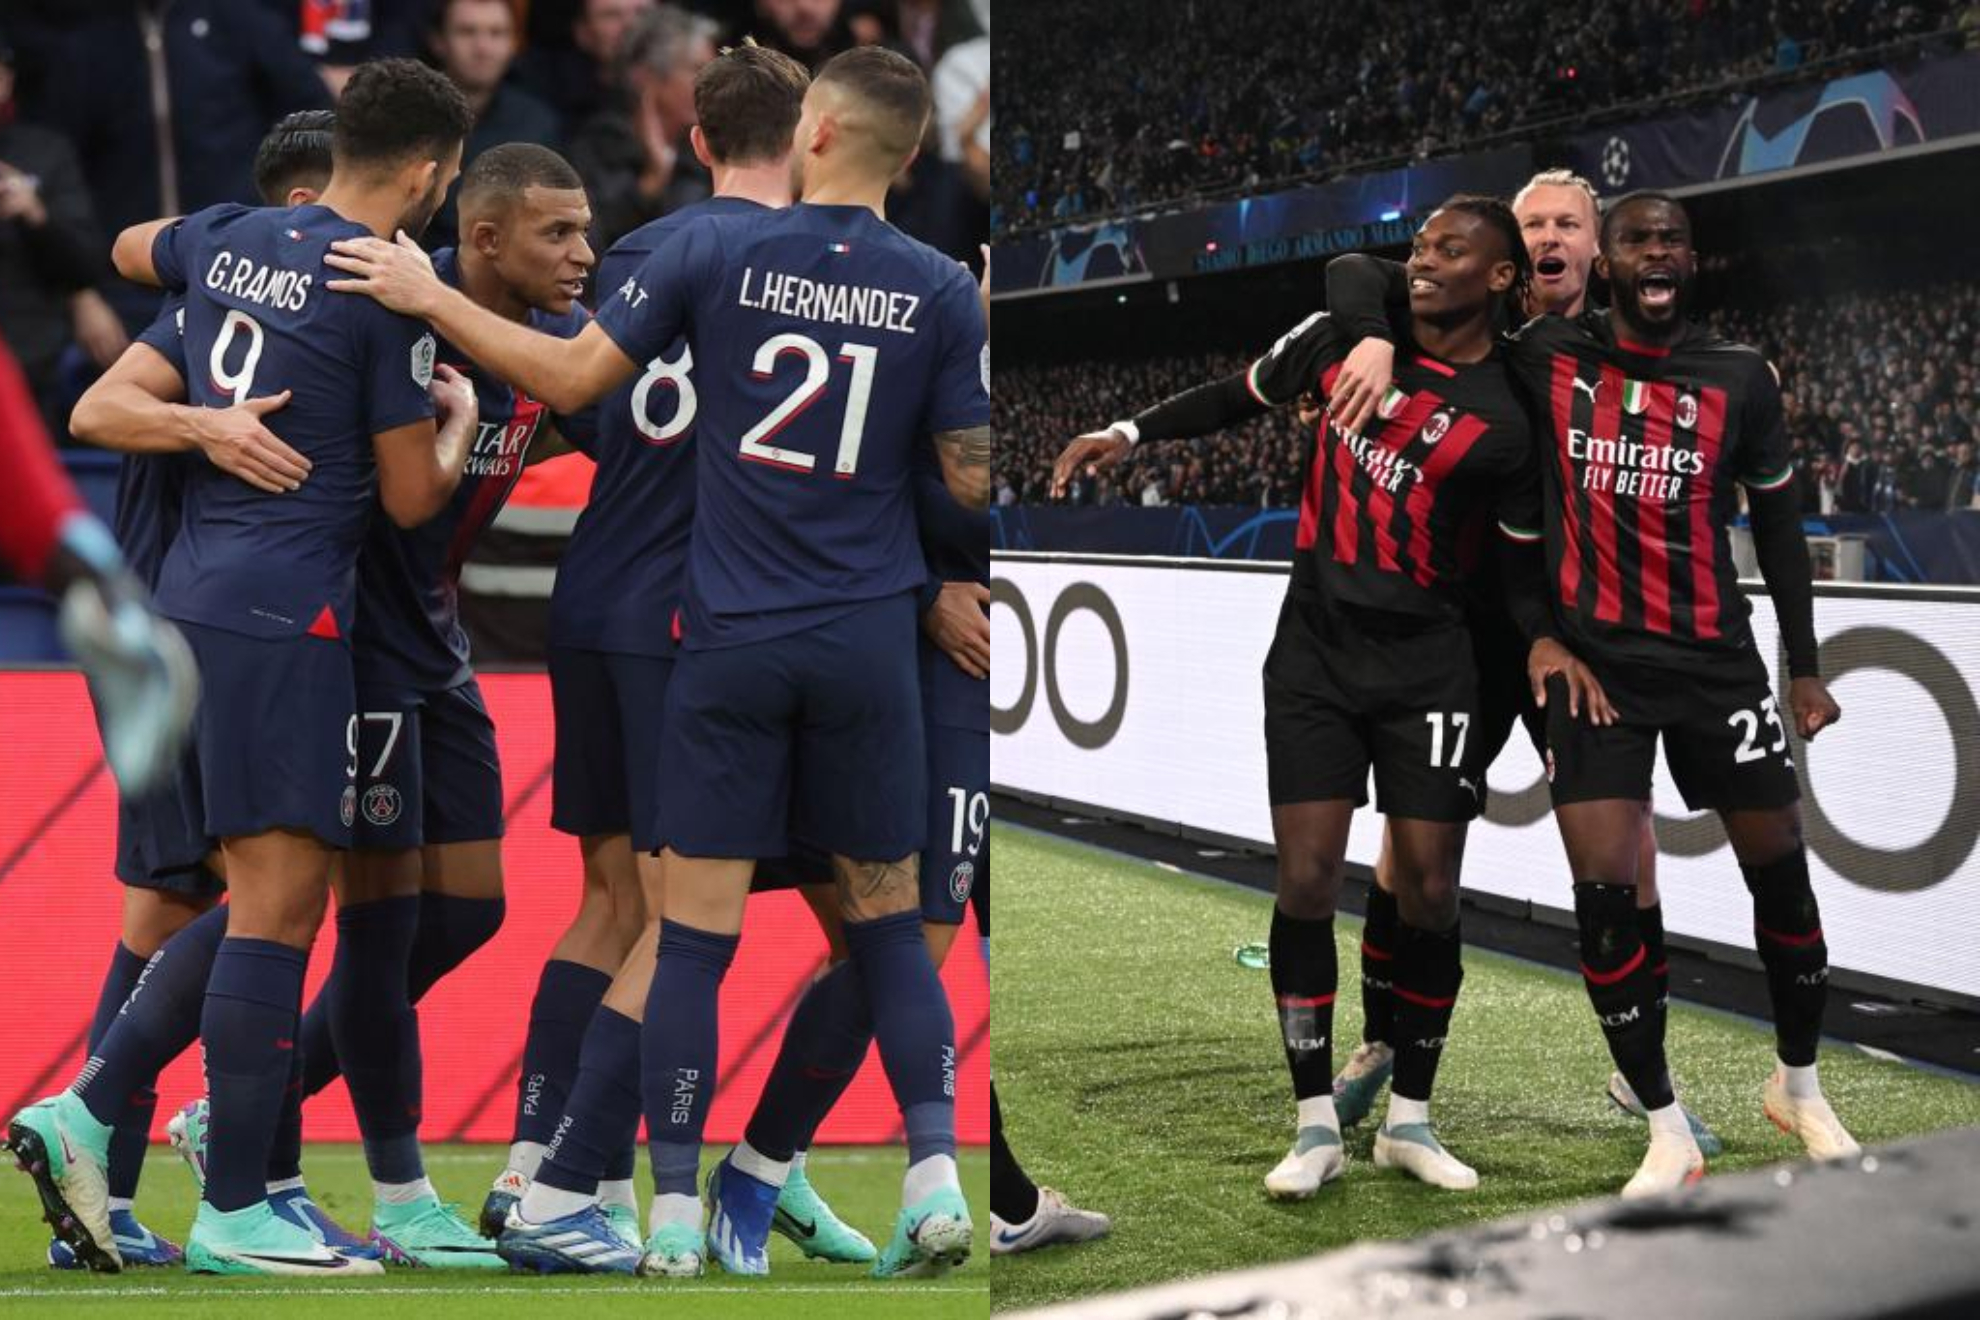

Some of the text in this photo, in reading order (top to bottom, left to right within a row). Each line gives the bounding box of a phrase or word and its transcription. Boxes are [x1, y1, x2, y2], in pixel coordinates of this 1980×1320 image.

[206, 251, 313, 311] G.RAMOS
[618, 276, 649, 308] AT
[738, 267, 920, 333] L.HERNANDEZ
[738, 332, 879, 480] 21
[473, 421, 528, 456] TAR
[1567, 428, 1705, 475] Emirates
[1583, 465, 1683, 500] FLY BETTER
[1426, 711, 1470, 767] 17
[1728, 694, 1786, 764] 23
[948, 787, 990, 856] 19
[671, 1067, 699, 1125] PARIS
[942, 1044, 955, 1097] PARIS
[542, 1114, 575, 1161] PARIS
